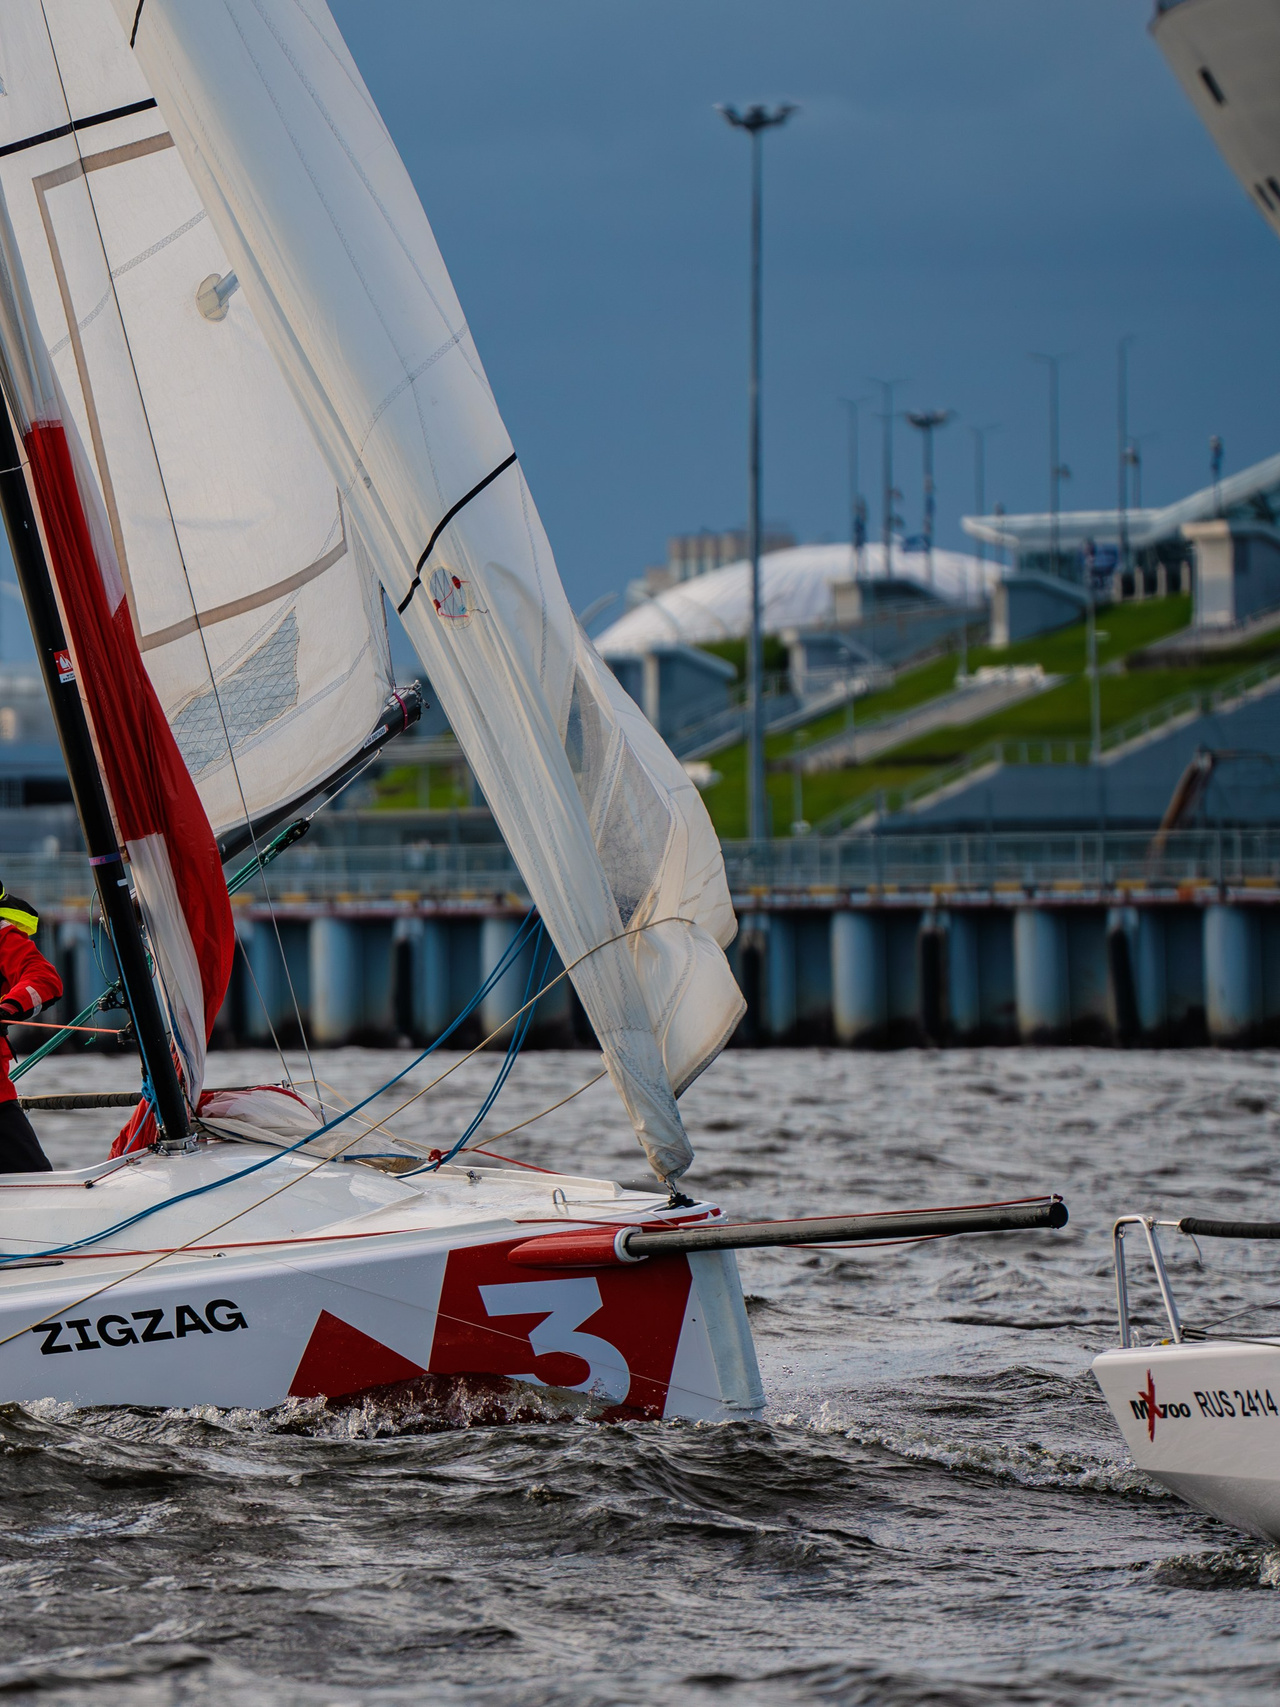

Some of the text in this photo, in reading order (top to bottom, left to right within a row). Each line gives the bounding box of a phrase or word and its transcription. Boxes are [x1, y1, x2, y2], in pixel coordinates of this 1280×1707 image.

[31, 1298, 249, 1356] ZIGZAG
[477, 1276, 631, 1406] 3
[1193, 1390, 1236, 1418] RUS
[1233, 1388, 1280, 1418] 2414
